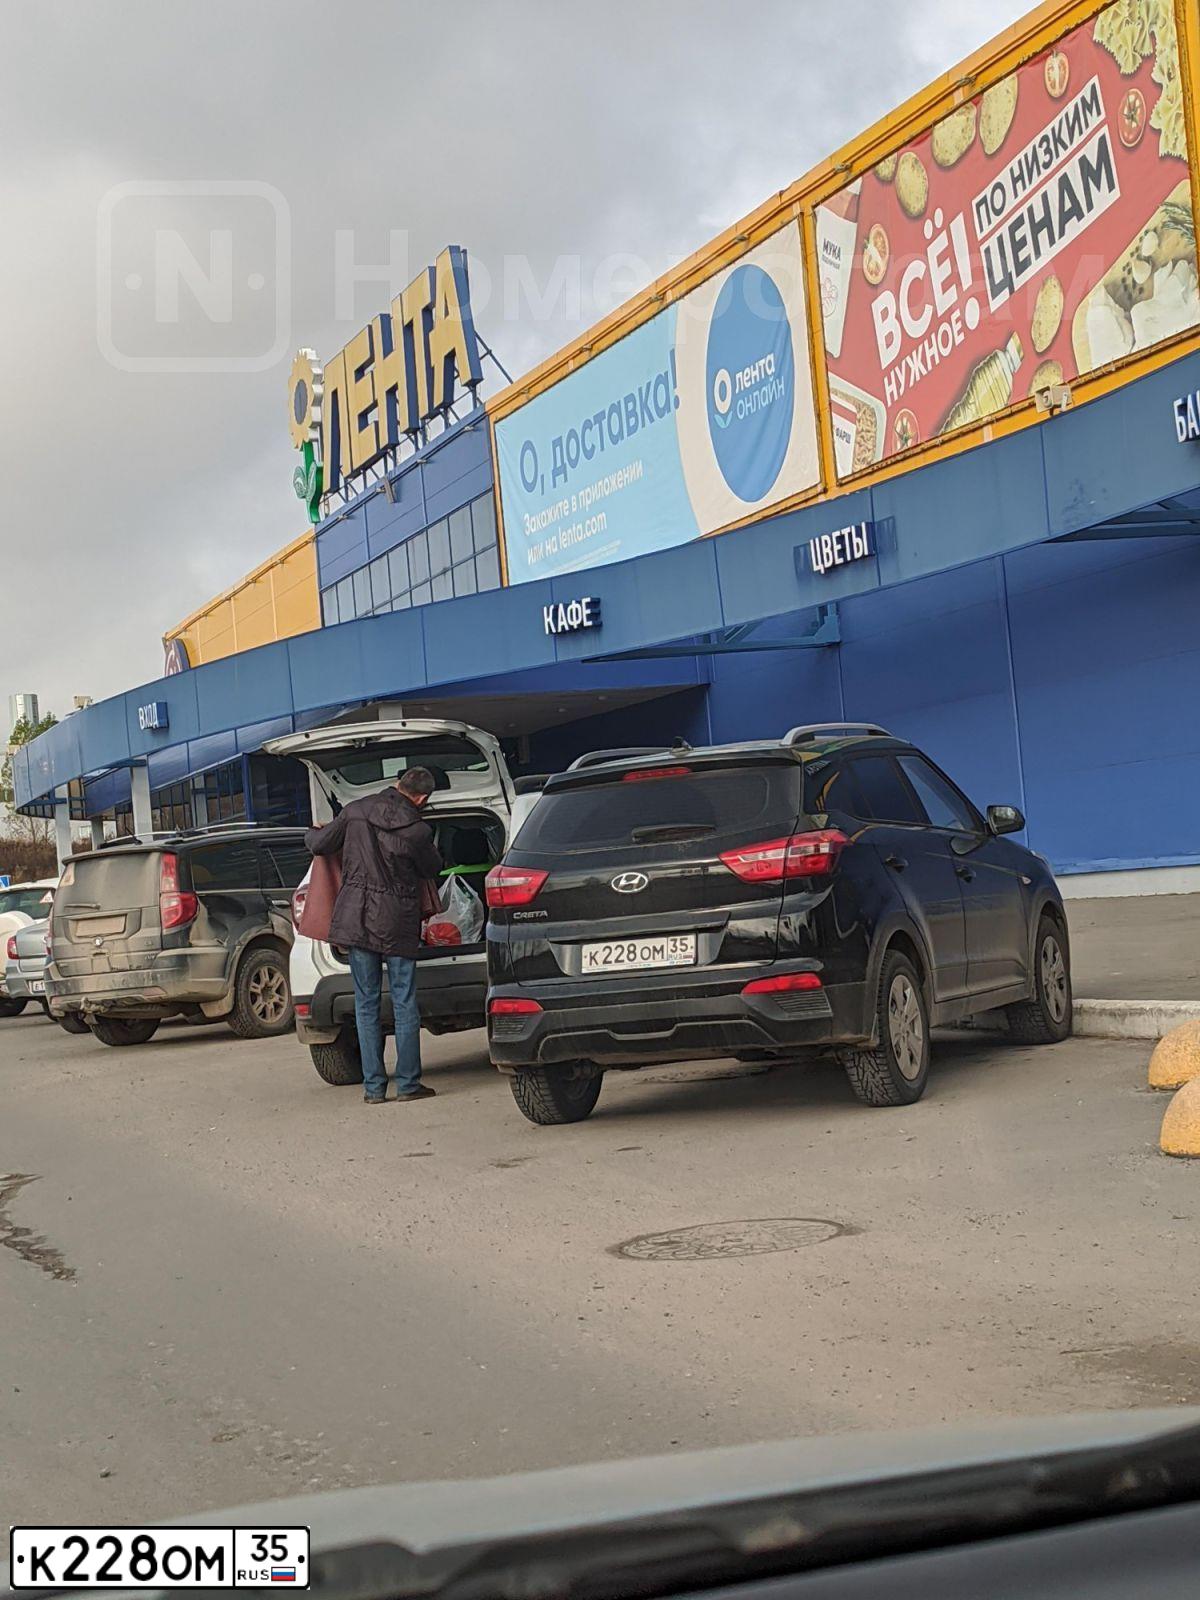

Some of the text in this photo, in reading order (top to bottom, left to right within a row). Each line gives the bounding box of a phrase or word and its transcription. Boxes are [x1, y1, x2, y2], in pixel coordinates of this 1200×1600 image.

[975, 82, 1101, 232] ПО НИЗКИМ
[984, 133, 1116, 300] ЦЕНАМ
[323, 245, 483, 496] ЛЕНТА
[735, 353, 776, 394] лента
[883, 308, 965, 407] НУЖНОЕ
[520, 349, 680, 496] О, доставка!
[736, 375, 785, 420] онлайн
[1173, 390, 1200, 442] БА
[523, 498, 569, 536] Закажите
[579, 459, 644, 512] приложении
[527, 545, 544, 566] или
[545, 536, 558, 556] на
[558, 511, 608, 549] lenta.com
[809, 522, 869, 575] ЦВЕТЫ
[543, 597, 593, 635] КАФЕ
[138, 702, 159, 730] ВХОД
[513, 910, 548, 920] CRETA
[669, 937, 689, 954] 35
